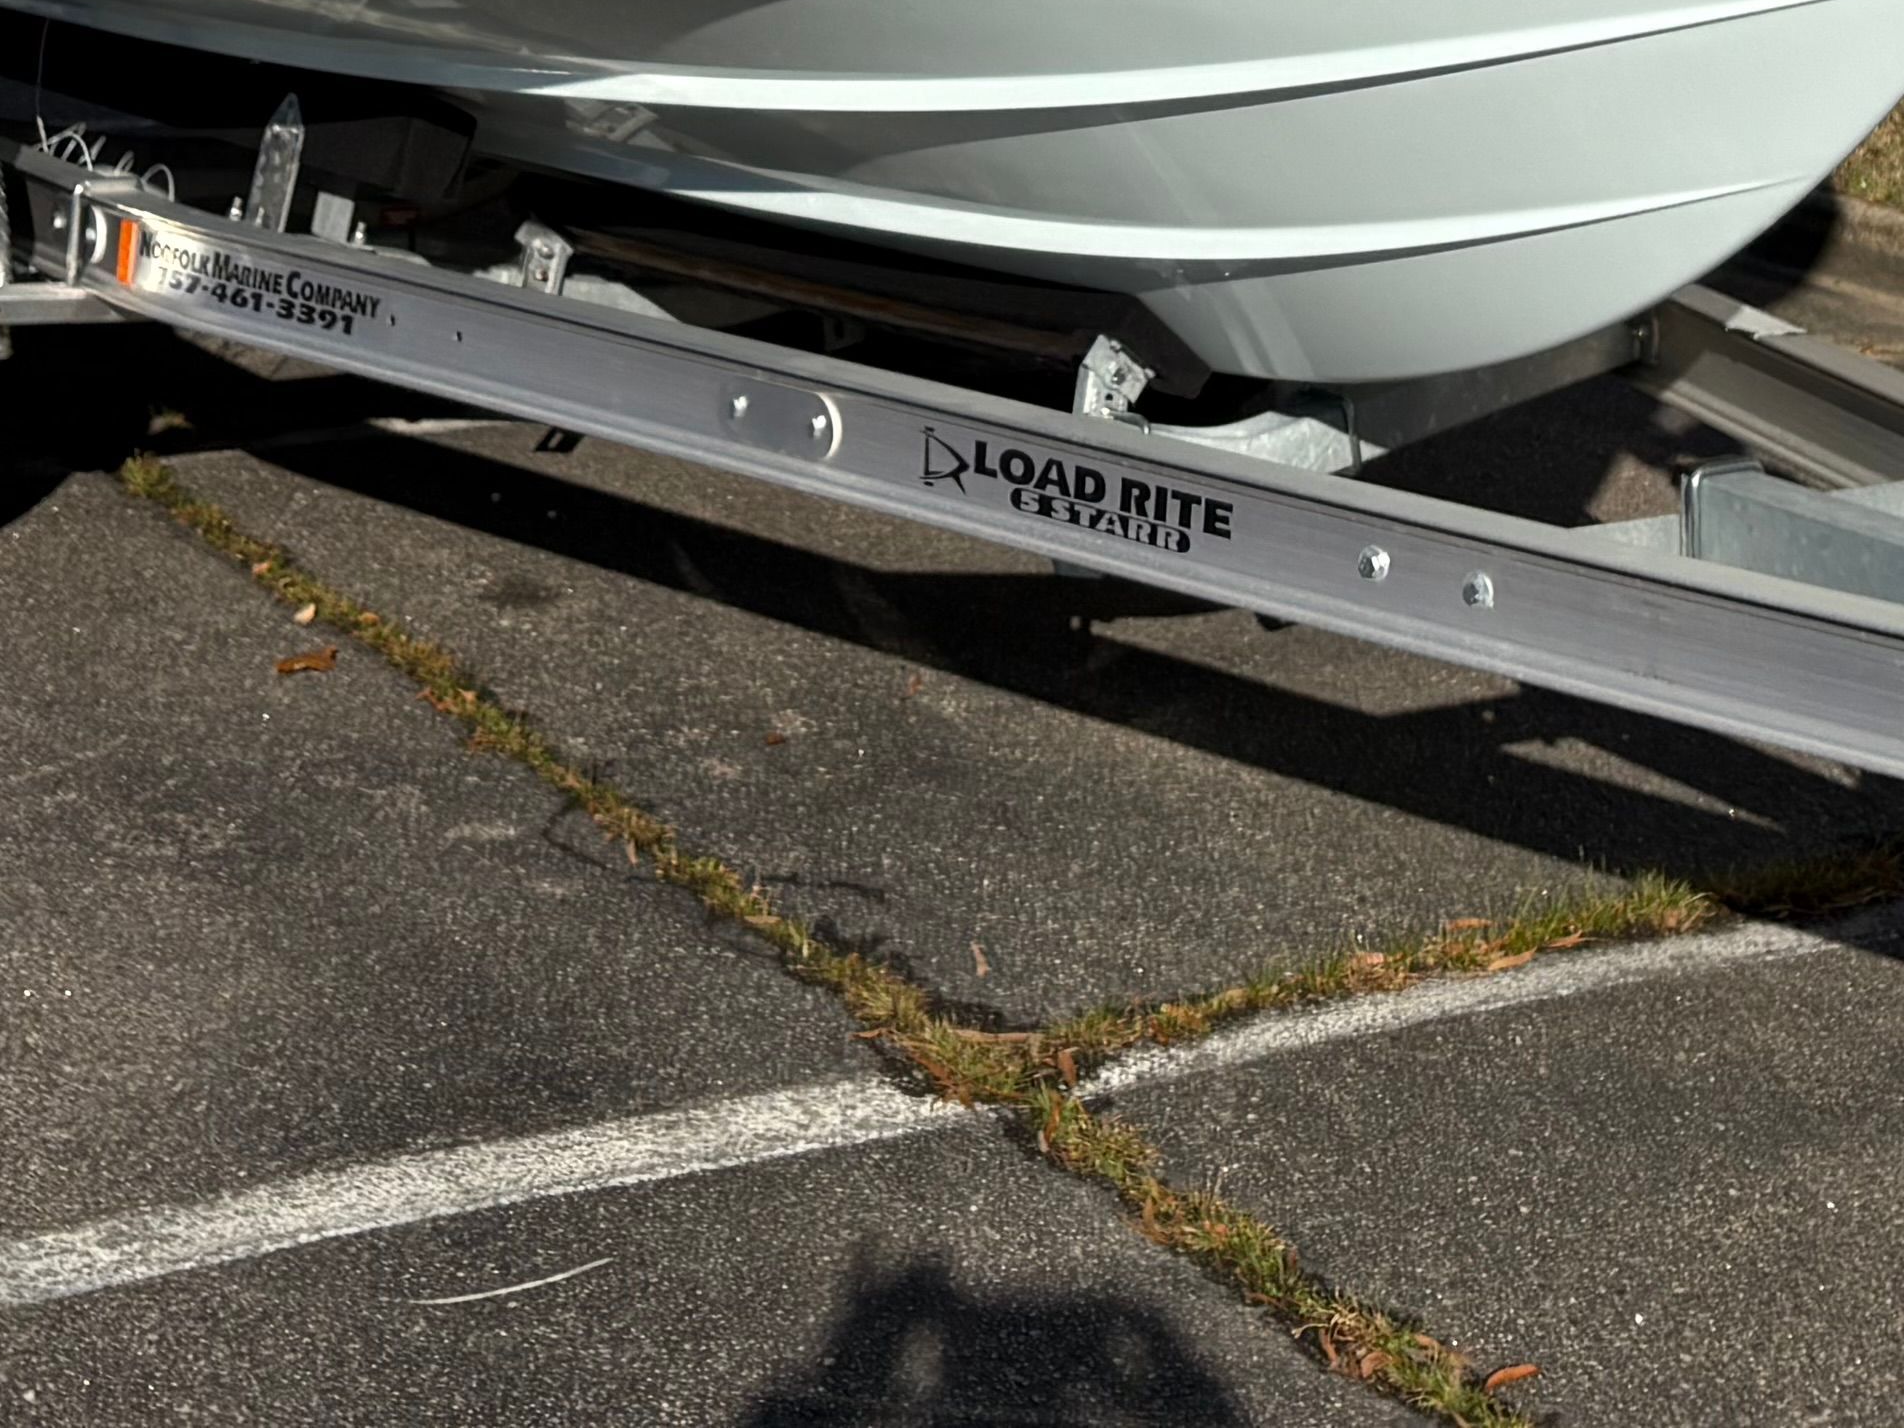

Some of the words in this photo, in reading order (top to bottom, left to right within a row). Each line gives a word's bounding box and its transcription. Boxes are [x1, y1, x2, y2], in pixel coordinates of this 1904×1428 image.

[158, 266, 354, 335] 757-461-3391
[212, 251, 284, 295] MARINE
[286, 270, 381, 318] COMPANY
[974, 440, 1106, 503] LOAD
[1119, 477, 1233, 539] RITE
[1019, 493, 1040, 512] 5
[1050, 500, 1183, 552] STARR
